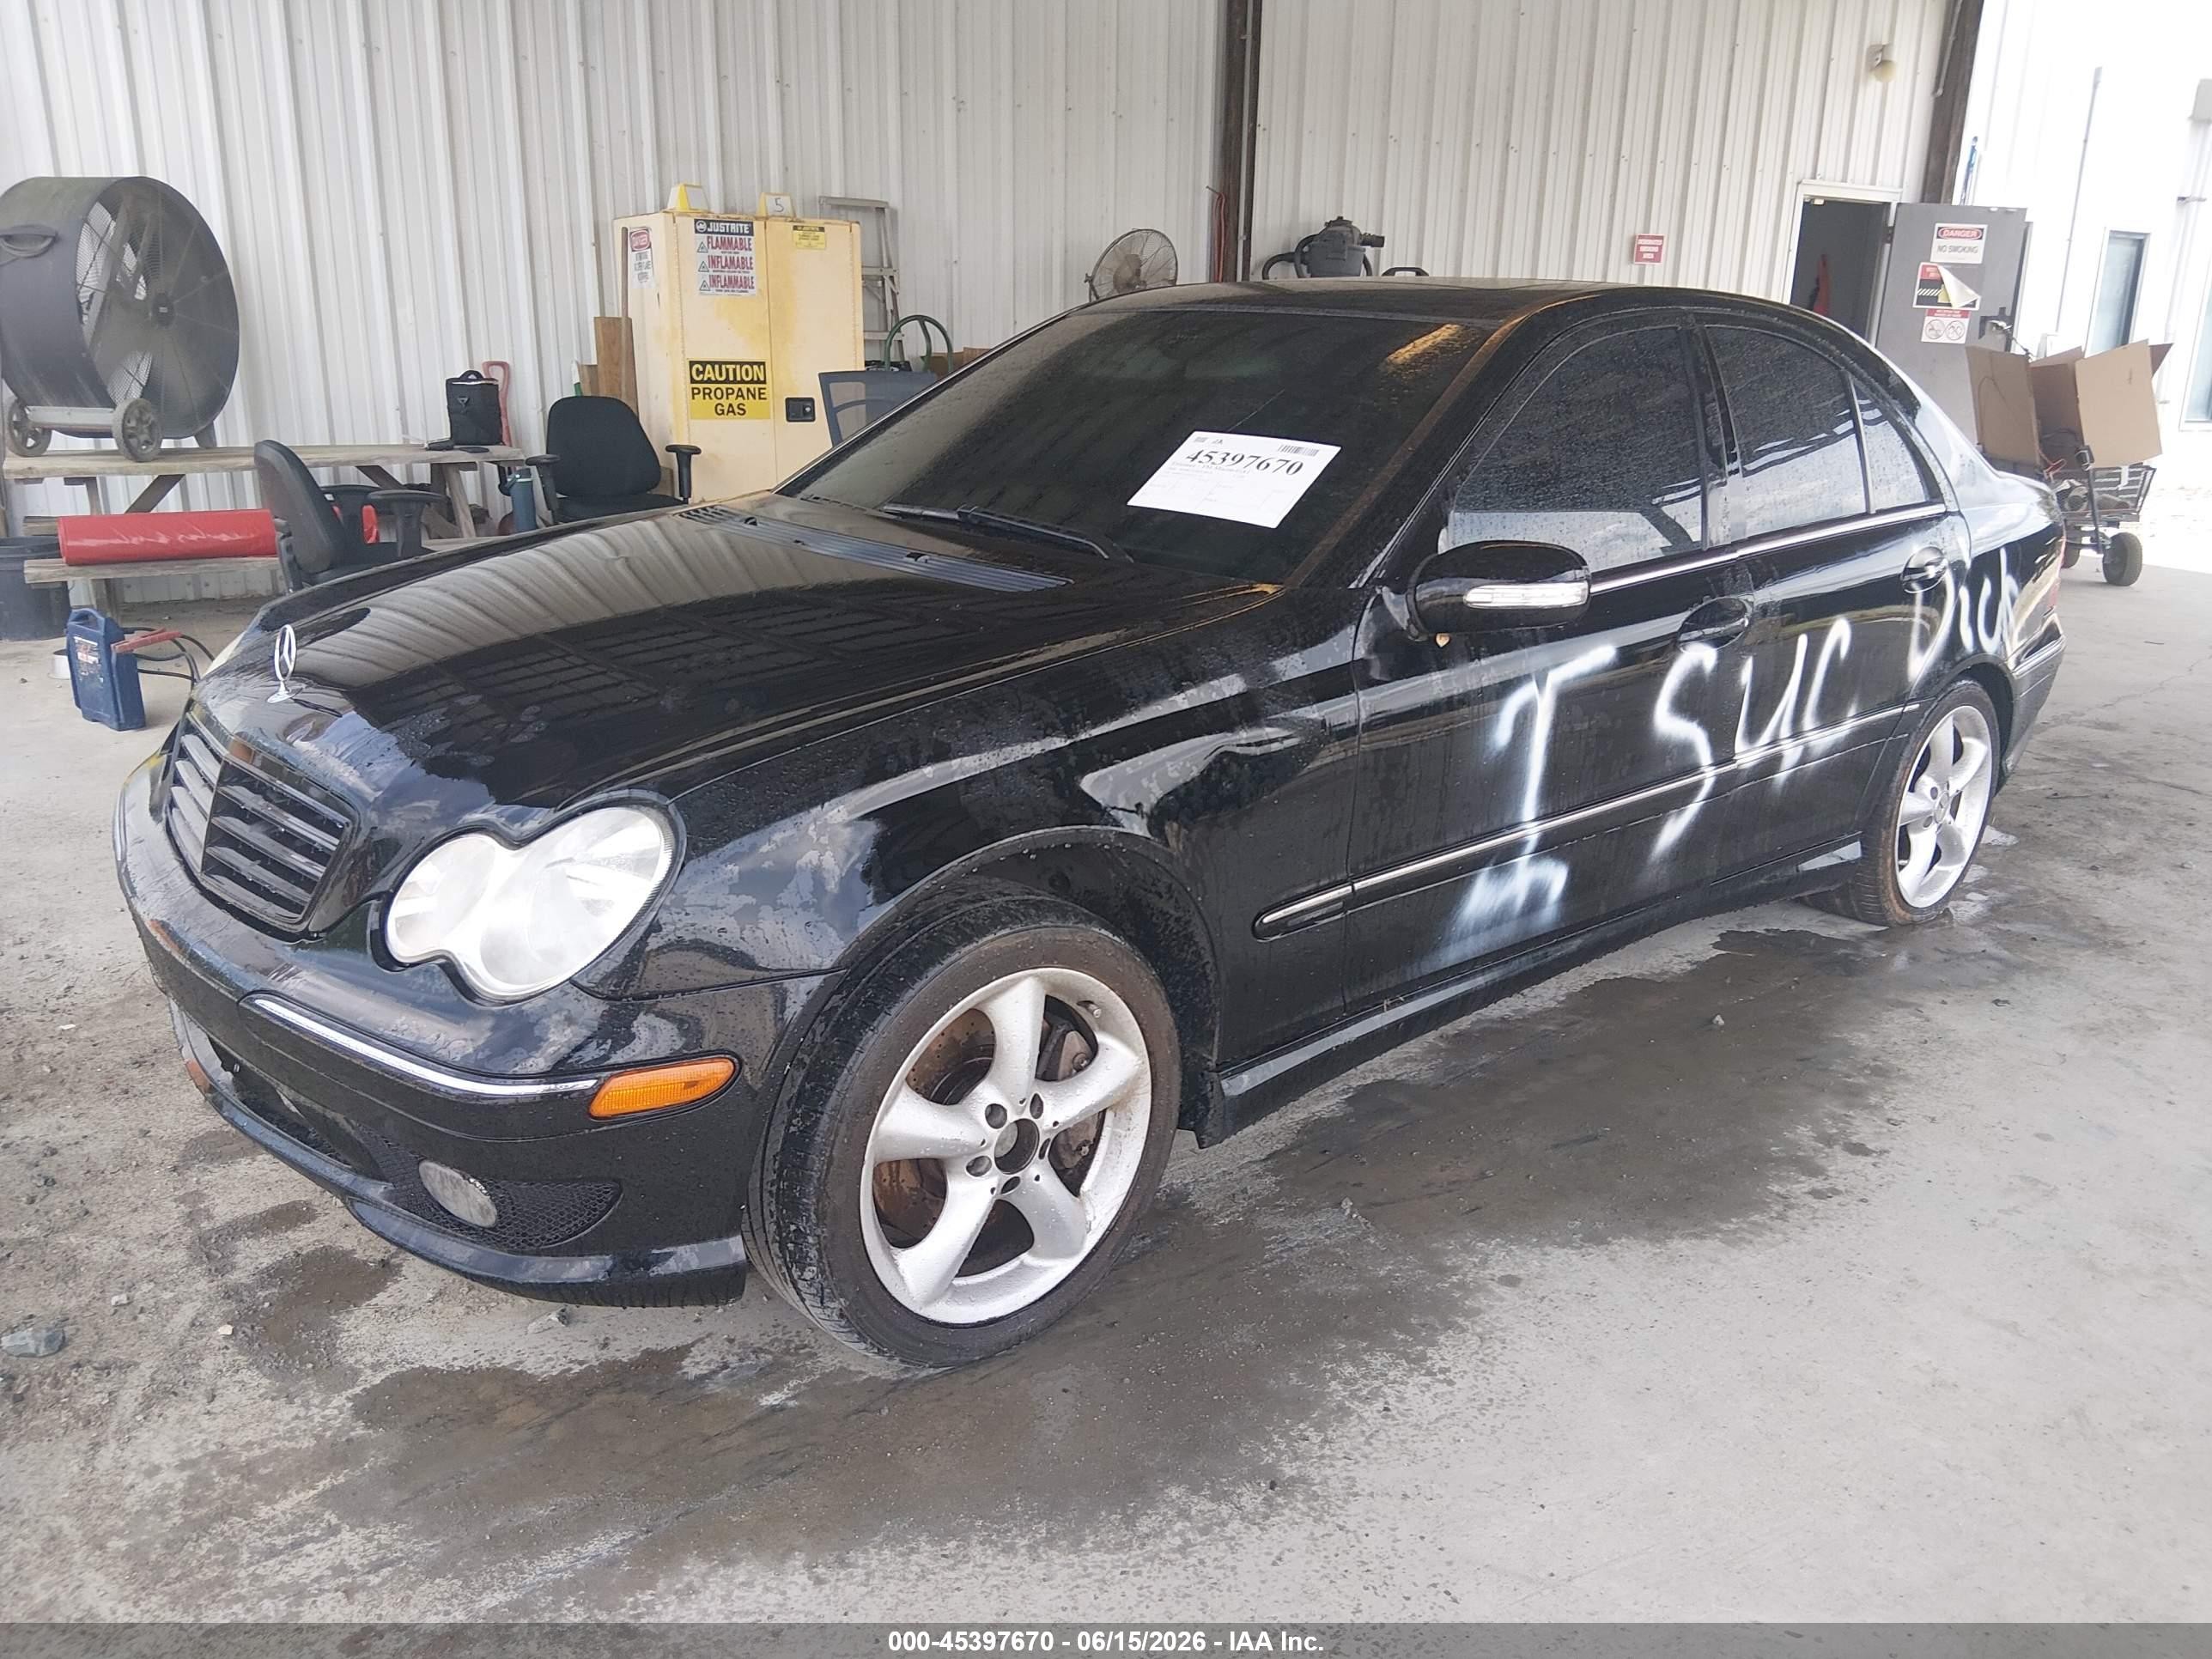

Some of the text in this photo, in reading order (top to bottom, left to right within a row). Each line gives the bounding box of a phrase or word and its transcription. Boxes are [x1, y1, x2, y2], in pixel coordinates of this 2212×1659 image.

[775, 197, 785, 213] 5
[708, 222, 750, 234] JUSTRITE
[1942, 229, 1978, 238] DANGER
[707, 235, 753, 252] FLAMMABLE
[1937, 245, 1979, 254] NO SMOKING
[708, 255, 754, 270] INFLAMABLE
[708, 274, 755, 289] INFLAMMABLE
[690, 363, 764, 381] CAUTION
[691, 386, 768, 400] PROPANE
[714, 403, 747, 416] GAS
[1186, 449, 1304, 476] 45397670
